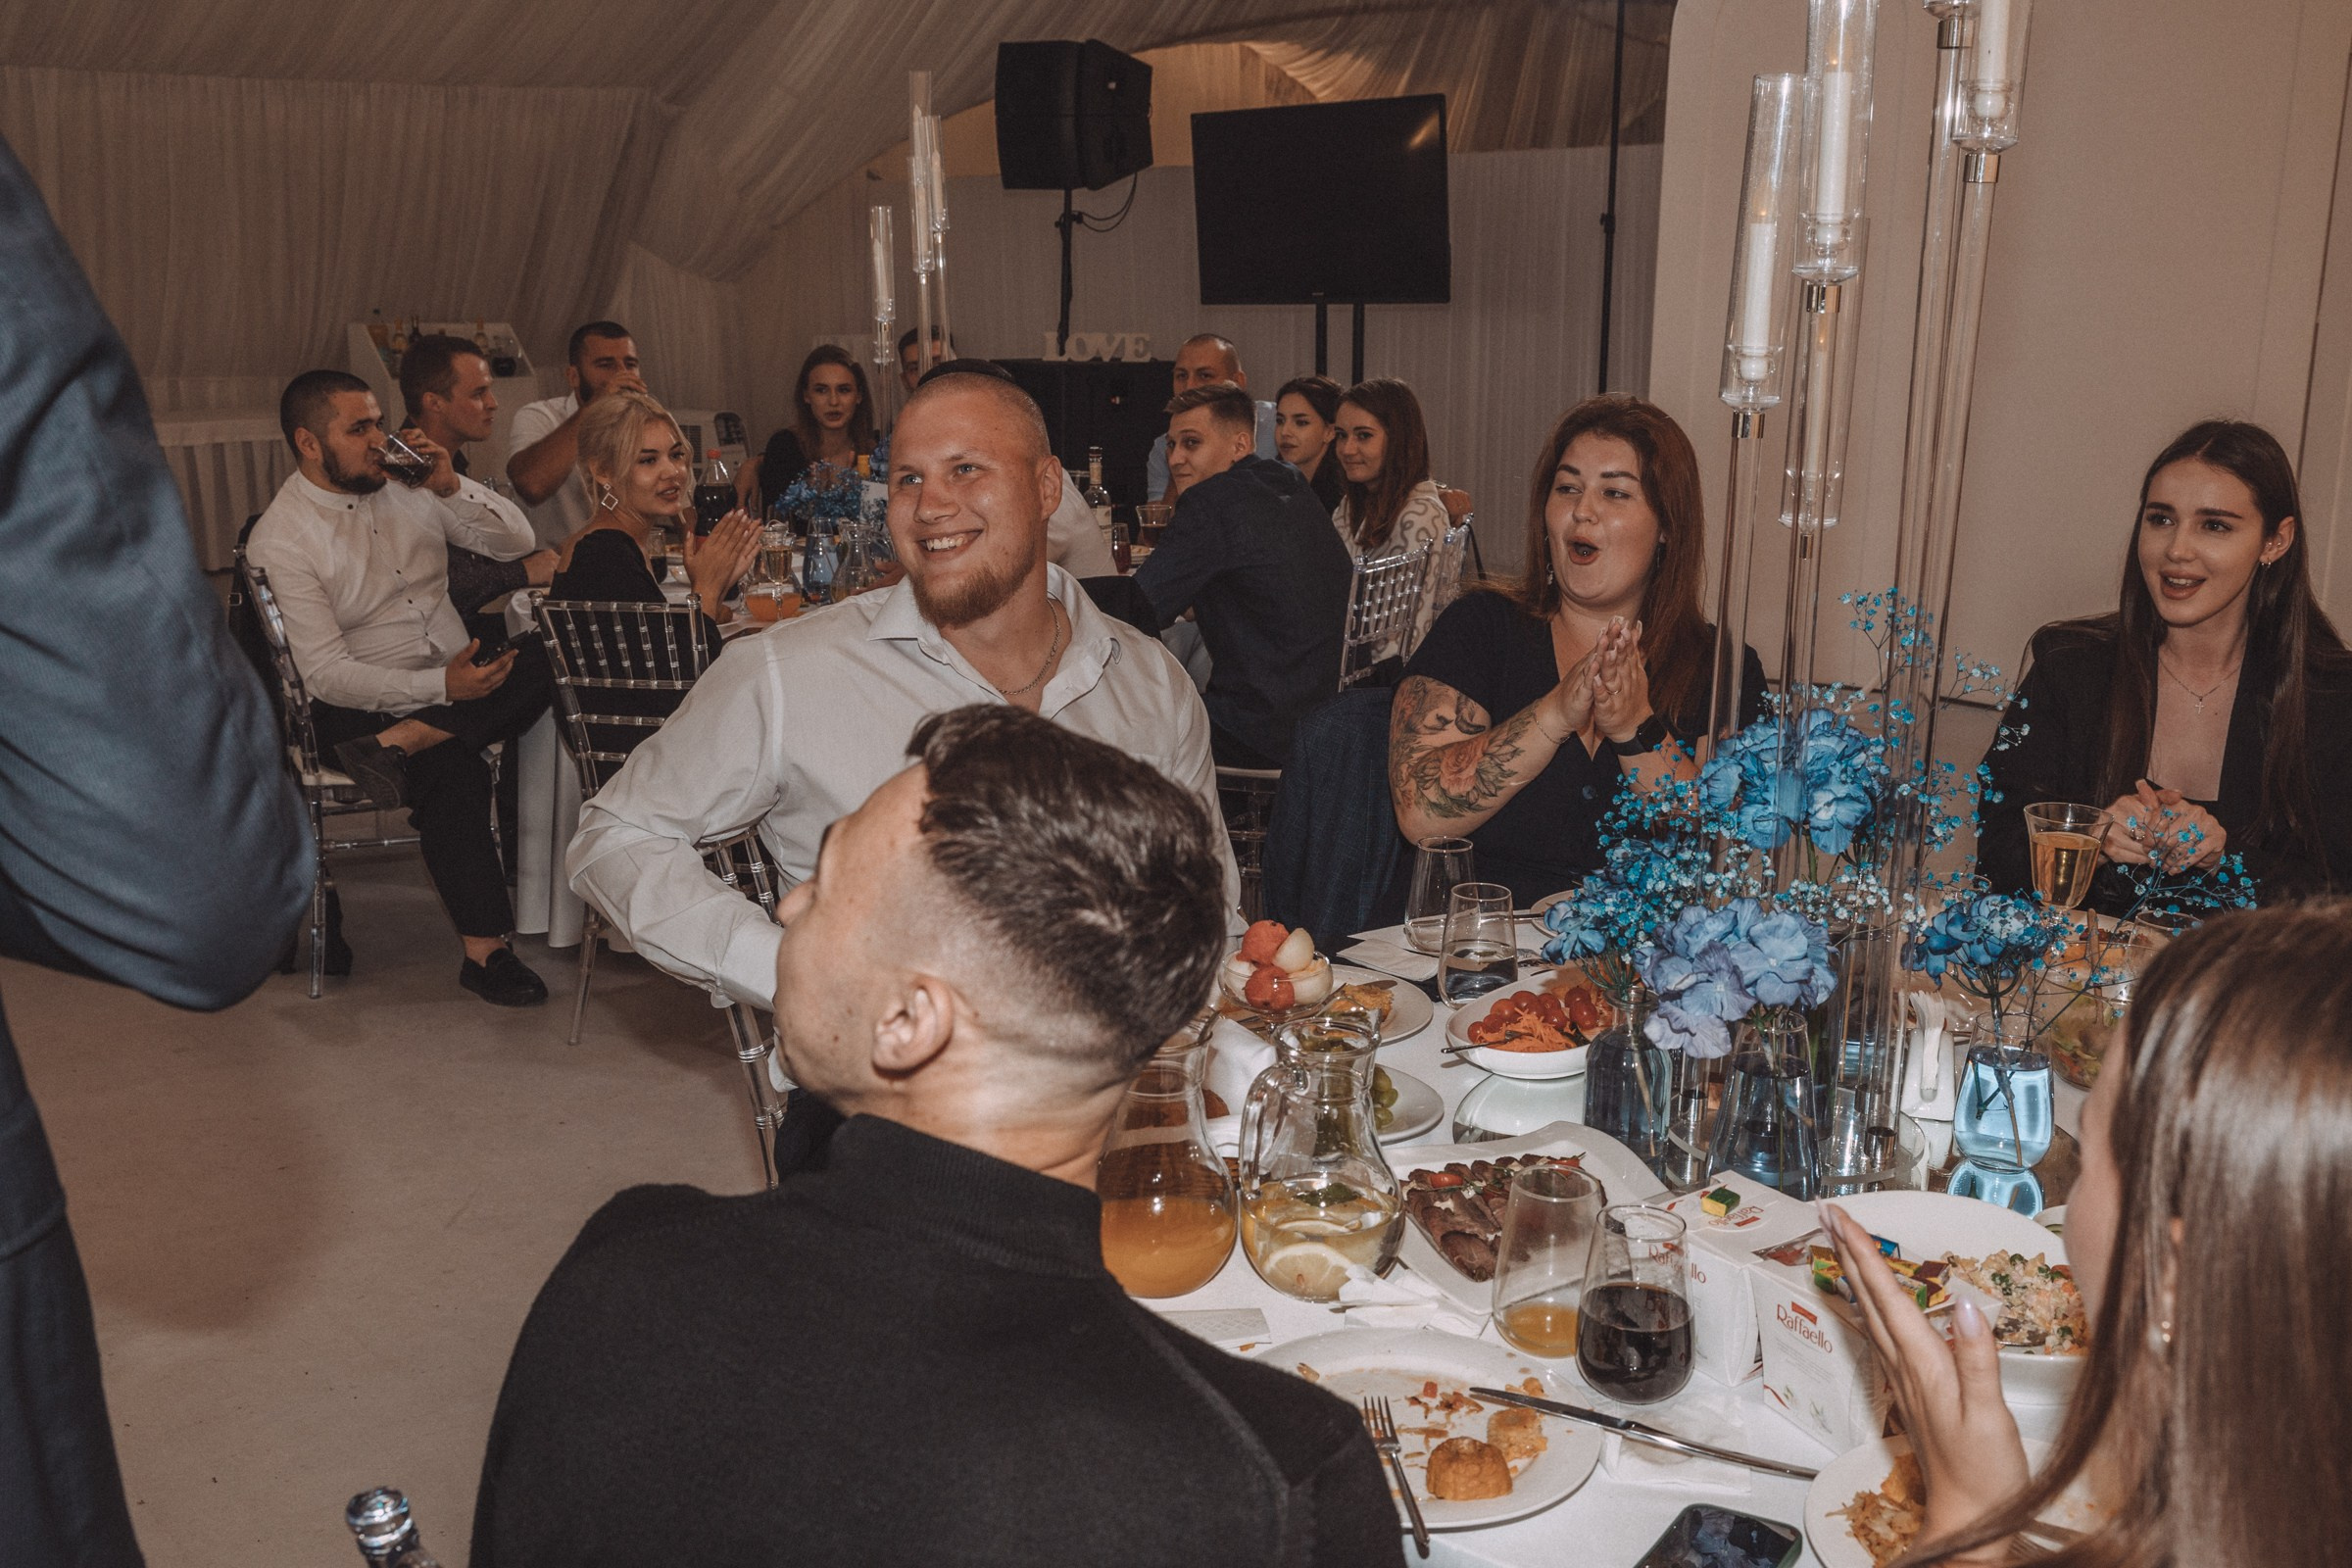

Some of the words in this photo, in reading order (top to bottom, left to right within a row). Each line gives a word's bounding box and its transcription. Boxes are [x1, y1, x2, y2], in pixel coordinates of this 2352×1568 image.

[1042, 331, 1152, 362] LOVE
[1648, 1244, 1707, 1284] Raffllo
[1777, 1303, 1833, 1353] Raffaello
